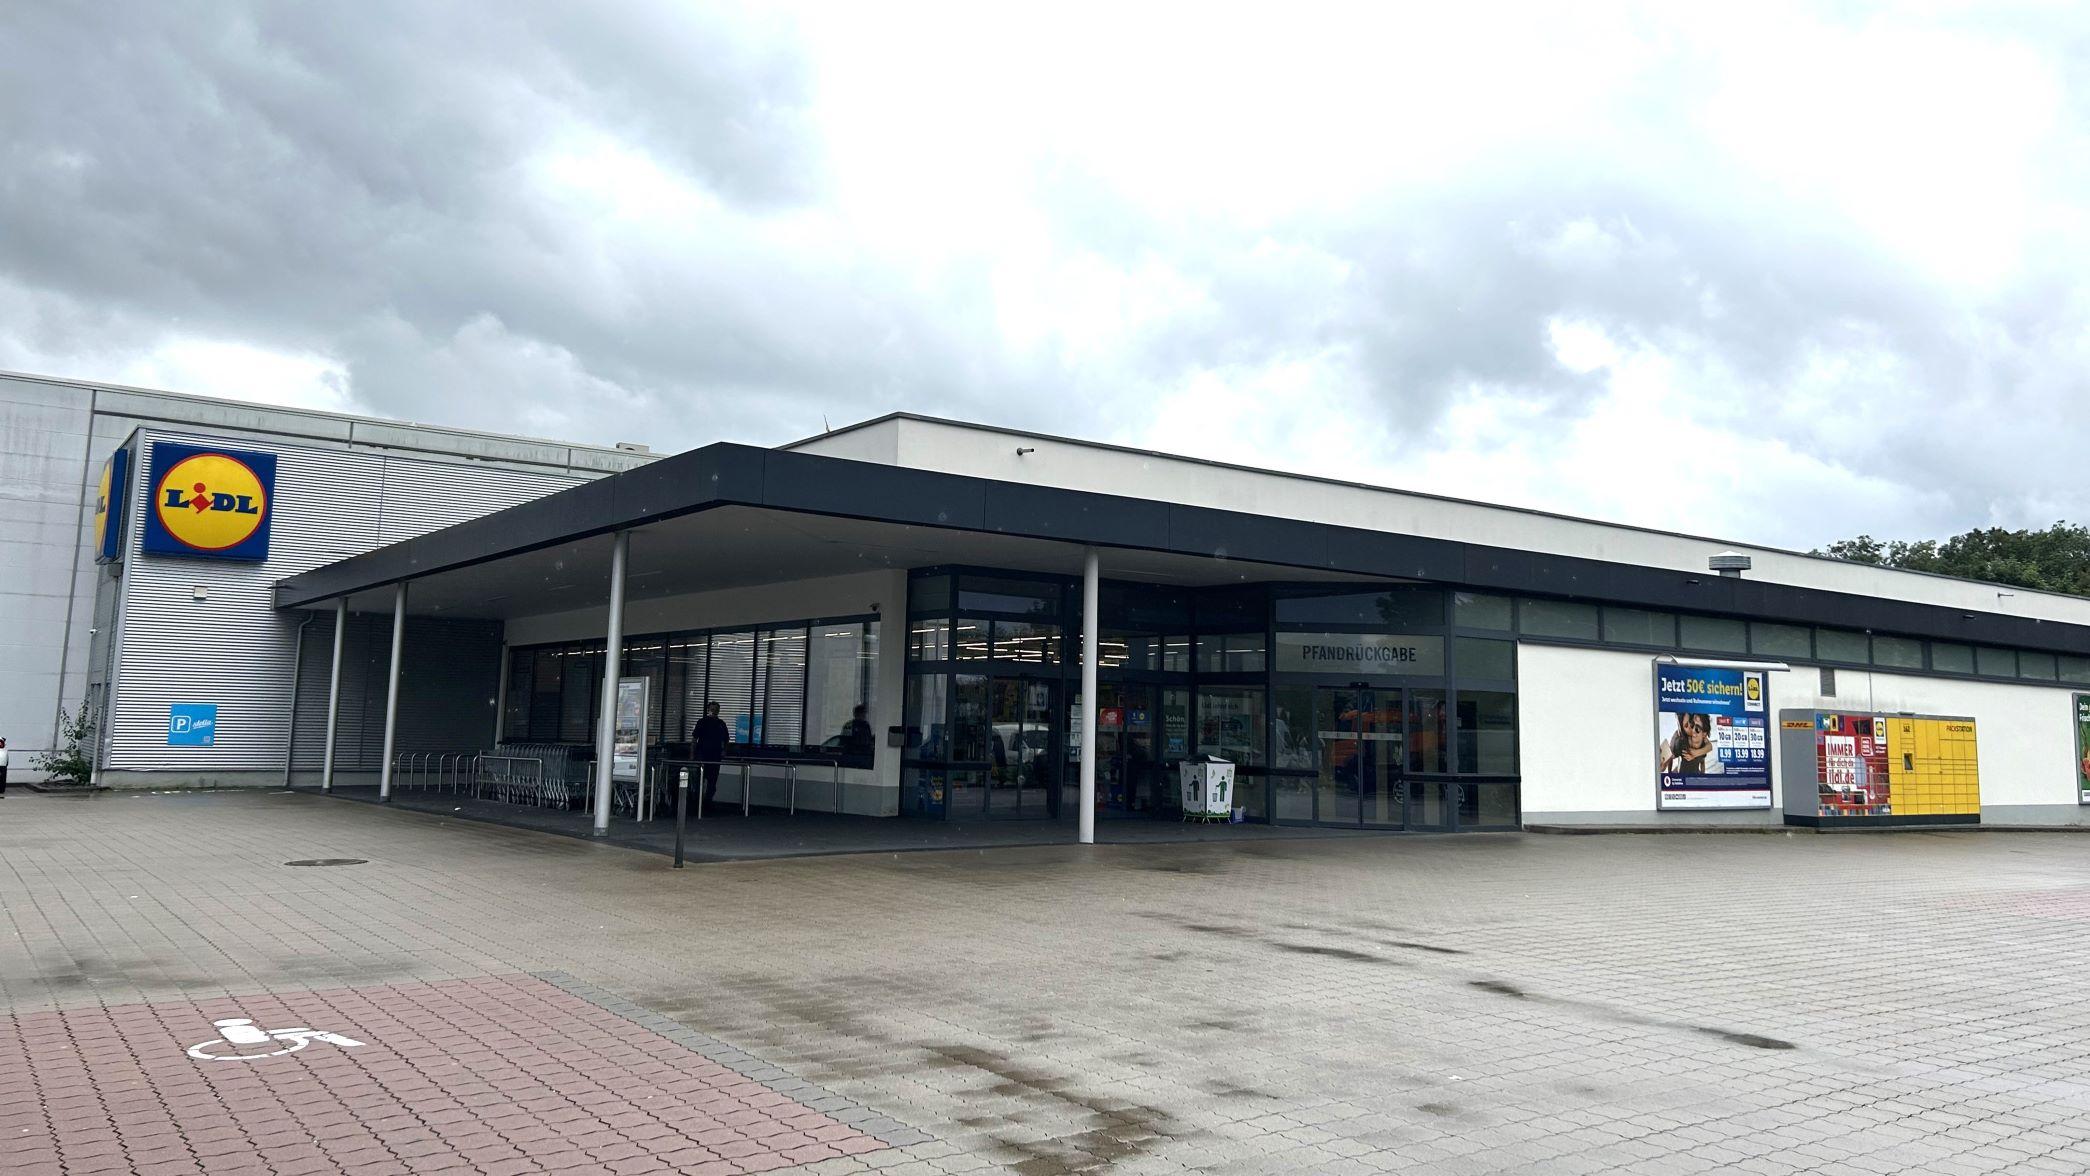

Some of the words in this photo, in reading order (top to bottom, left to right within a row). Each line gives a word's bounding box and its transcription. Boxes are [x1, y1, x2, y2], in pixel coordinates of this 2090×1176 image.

[1302, 643, 1417, 662] PFANDRÜCKGABE
[1662, 677, 1685, 692] Jetzt
[1686, 678, 1705, 694] 50€
[1707, 680, 1742, 695] sichern!
[176, 718, 187, 730] P
[1720, 748, 1732, 758] 8.99
[1735, 748, 1749, 758] 13.99
[1750, 748, 1764, 758] 18.99
[1827, 743, 1854, 757] IMMER
[1828, 768, 1855, 785] lidl.de
